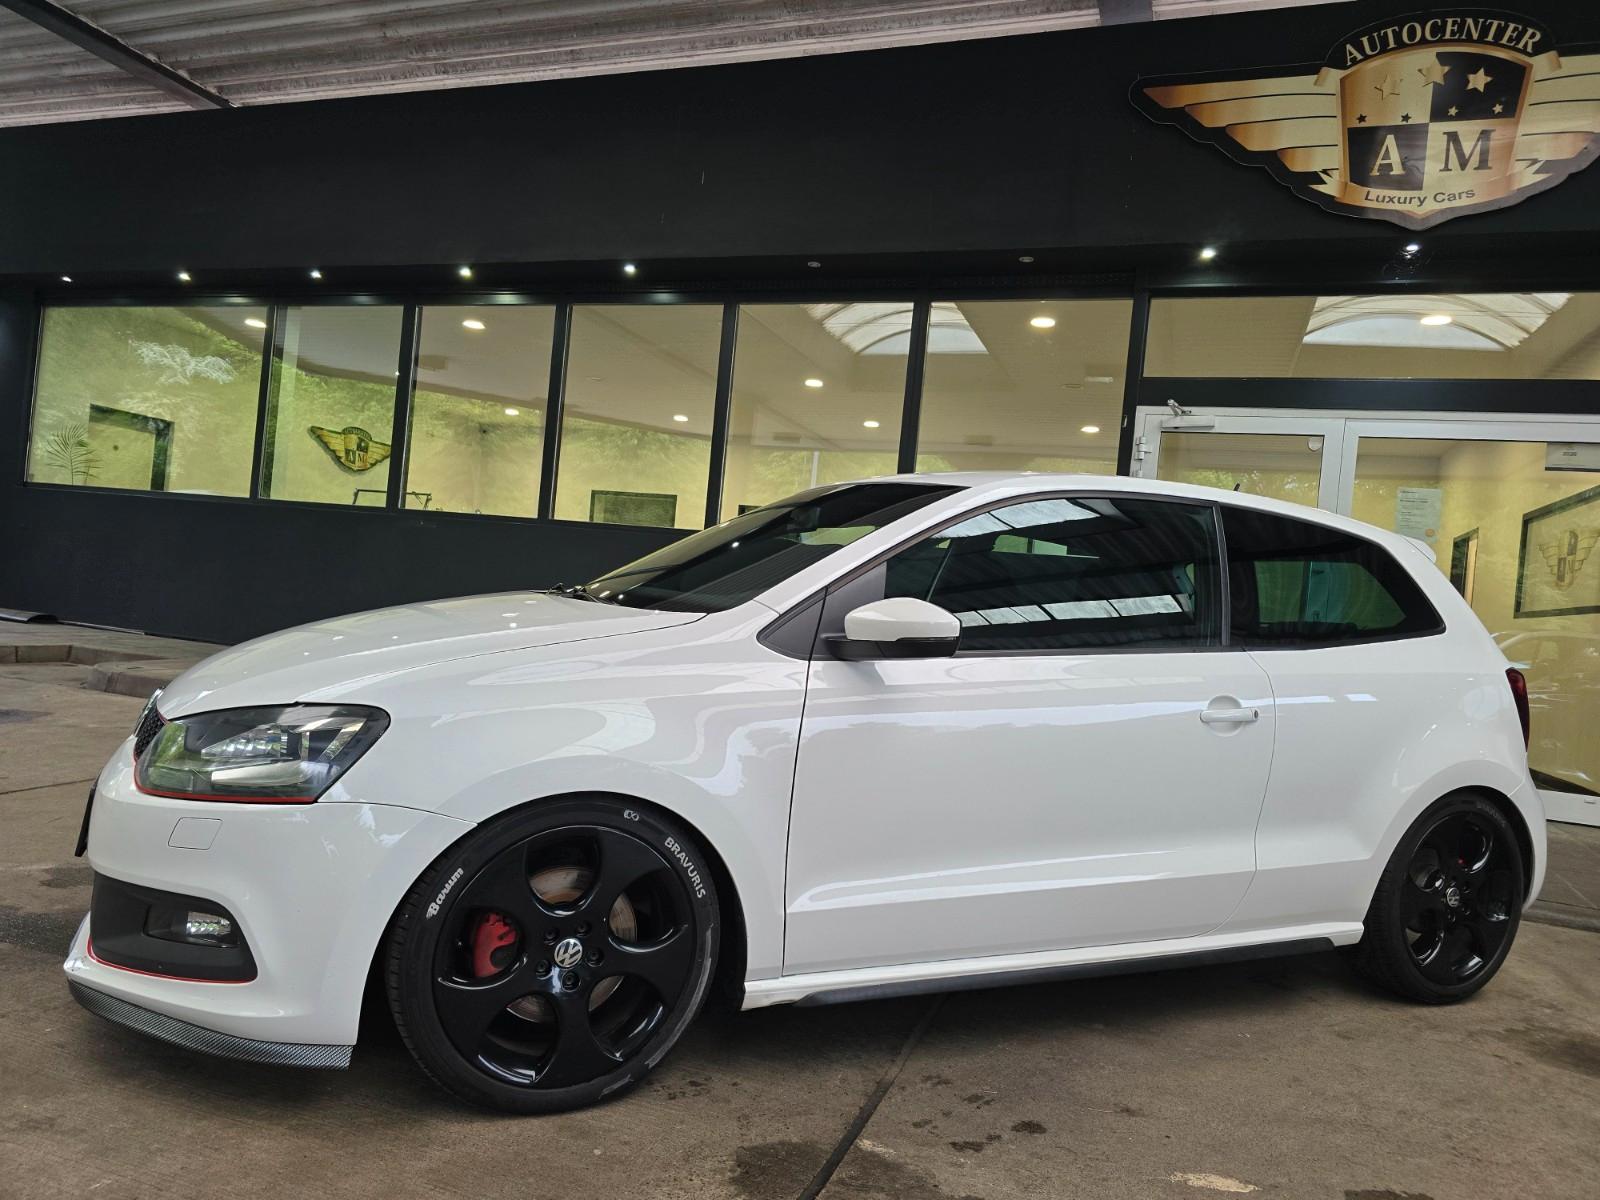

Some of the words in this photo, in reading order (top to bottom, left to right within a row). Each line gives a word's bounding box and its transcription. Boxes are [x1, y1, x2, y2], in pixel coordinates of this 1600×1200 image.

[1345, 17, 1541, 65] AUTOCENTER
[1369, 134, 1406, 176] A
[1439, 129, 1496, 172] M
[1364, 190, 1427, 207] Luxury
[1433, 189, 1476, 203] Cars
[664, 836, 706, 898] BRAVURIS
[426, 867, 464, 919] Barum
